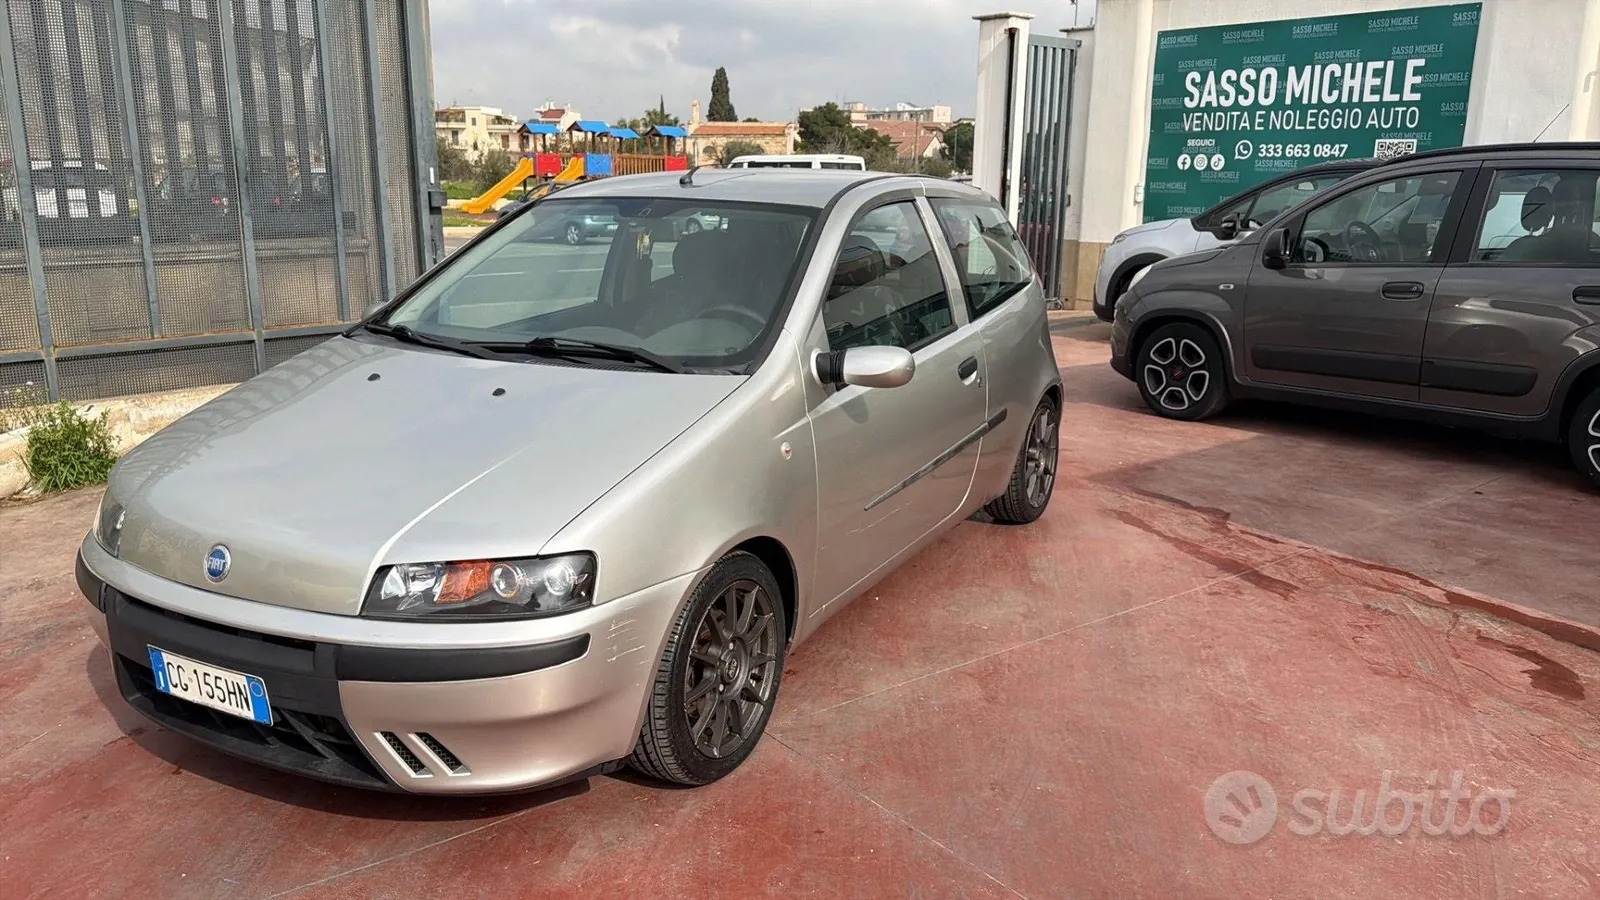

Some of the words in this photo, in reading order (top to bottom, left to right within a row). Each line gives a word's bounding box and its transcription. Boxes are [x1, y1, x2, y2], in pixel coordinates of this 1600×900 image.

[1368, 19, 1390, 28] SASSO
[1391, 16, 1419, 26] MICHELE
[1453, 11, 1477, 21] SASSO
[1293, 25, 1311, 34] SASSO
[1313, 22, 1338, 32] MICHELE
[1314, 51, 1334, 60] SASSO
[1335, 49, 1361, 58] MICHELE
[1391, 46, 1413, 55] SASSO
[1414, 43, 1444, 53] MICHELE
[1440, 72, 1469, 81] MICHELE
[1184, 67, 1278, 108] SASSO
[1285, 59, 1426, 105] MICHELE
[1441, 102, 1464, 111] SASSO
[1183, 111, 1250, 132] VENDITA
[1254, 110, 1266, 130] E
[1269, 108, 1361, 130] NOLEGGIO
[1365, 107, 1419, 129] AUTO
[1187, 139, 1215, 147] SEGUICI
[1258, 144, 1282, 157] 333
[1285, 144, 1310, 157] 663
[1313, 144, 1348, 157] 0847
[207, 556, 226, 571] FIAT
